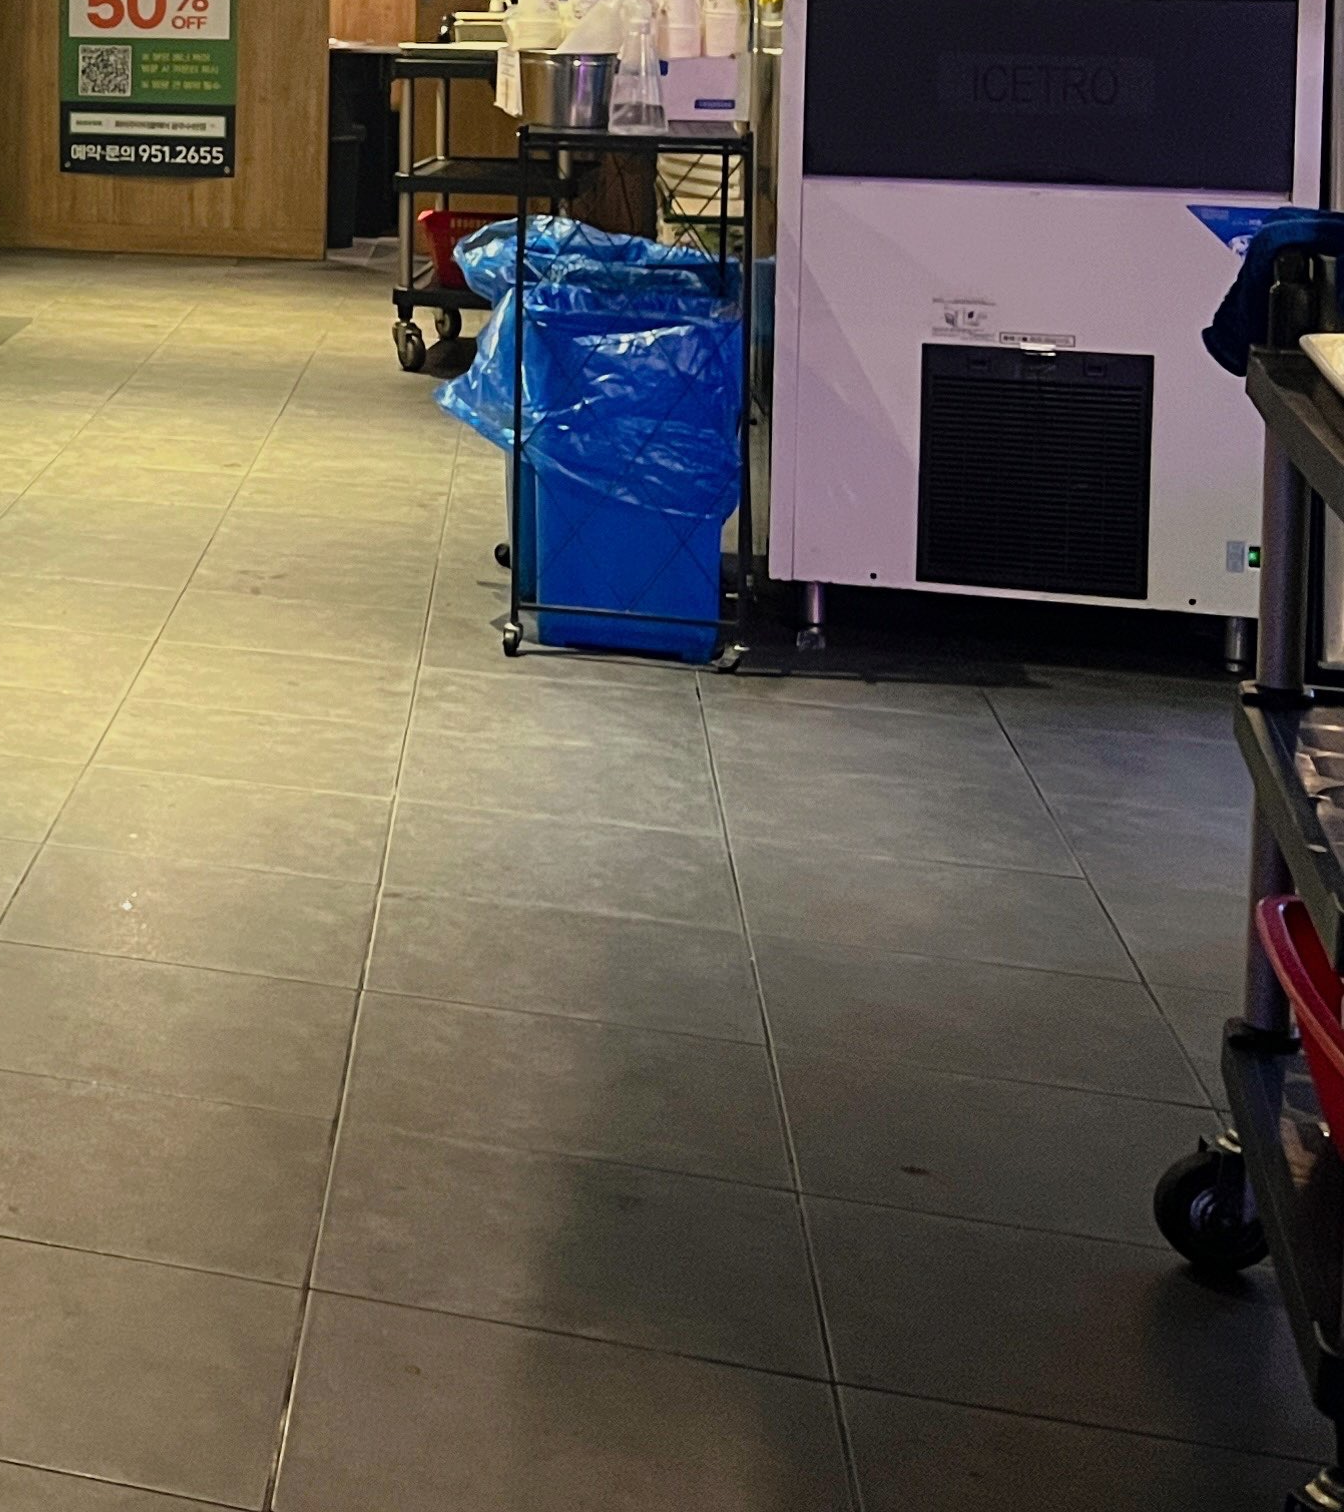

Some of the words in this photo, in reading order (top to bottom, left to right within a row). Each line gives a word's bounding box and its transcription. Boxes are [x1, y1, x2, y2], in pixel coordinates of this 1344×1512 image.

[171, 15, 208, 29] OFF
[972, 63, 1119, 106] ICETRO
[139, 144, 224, 165] 951.2655
